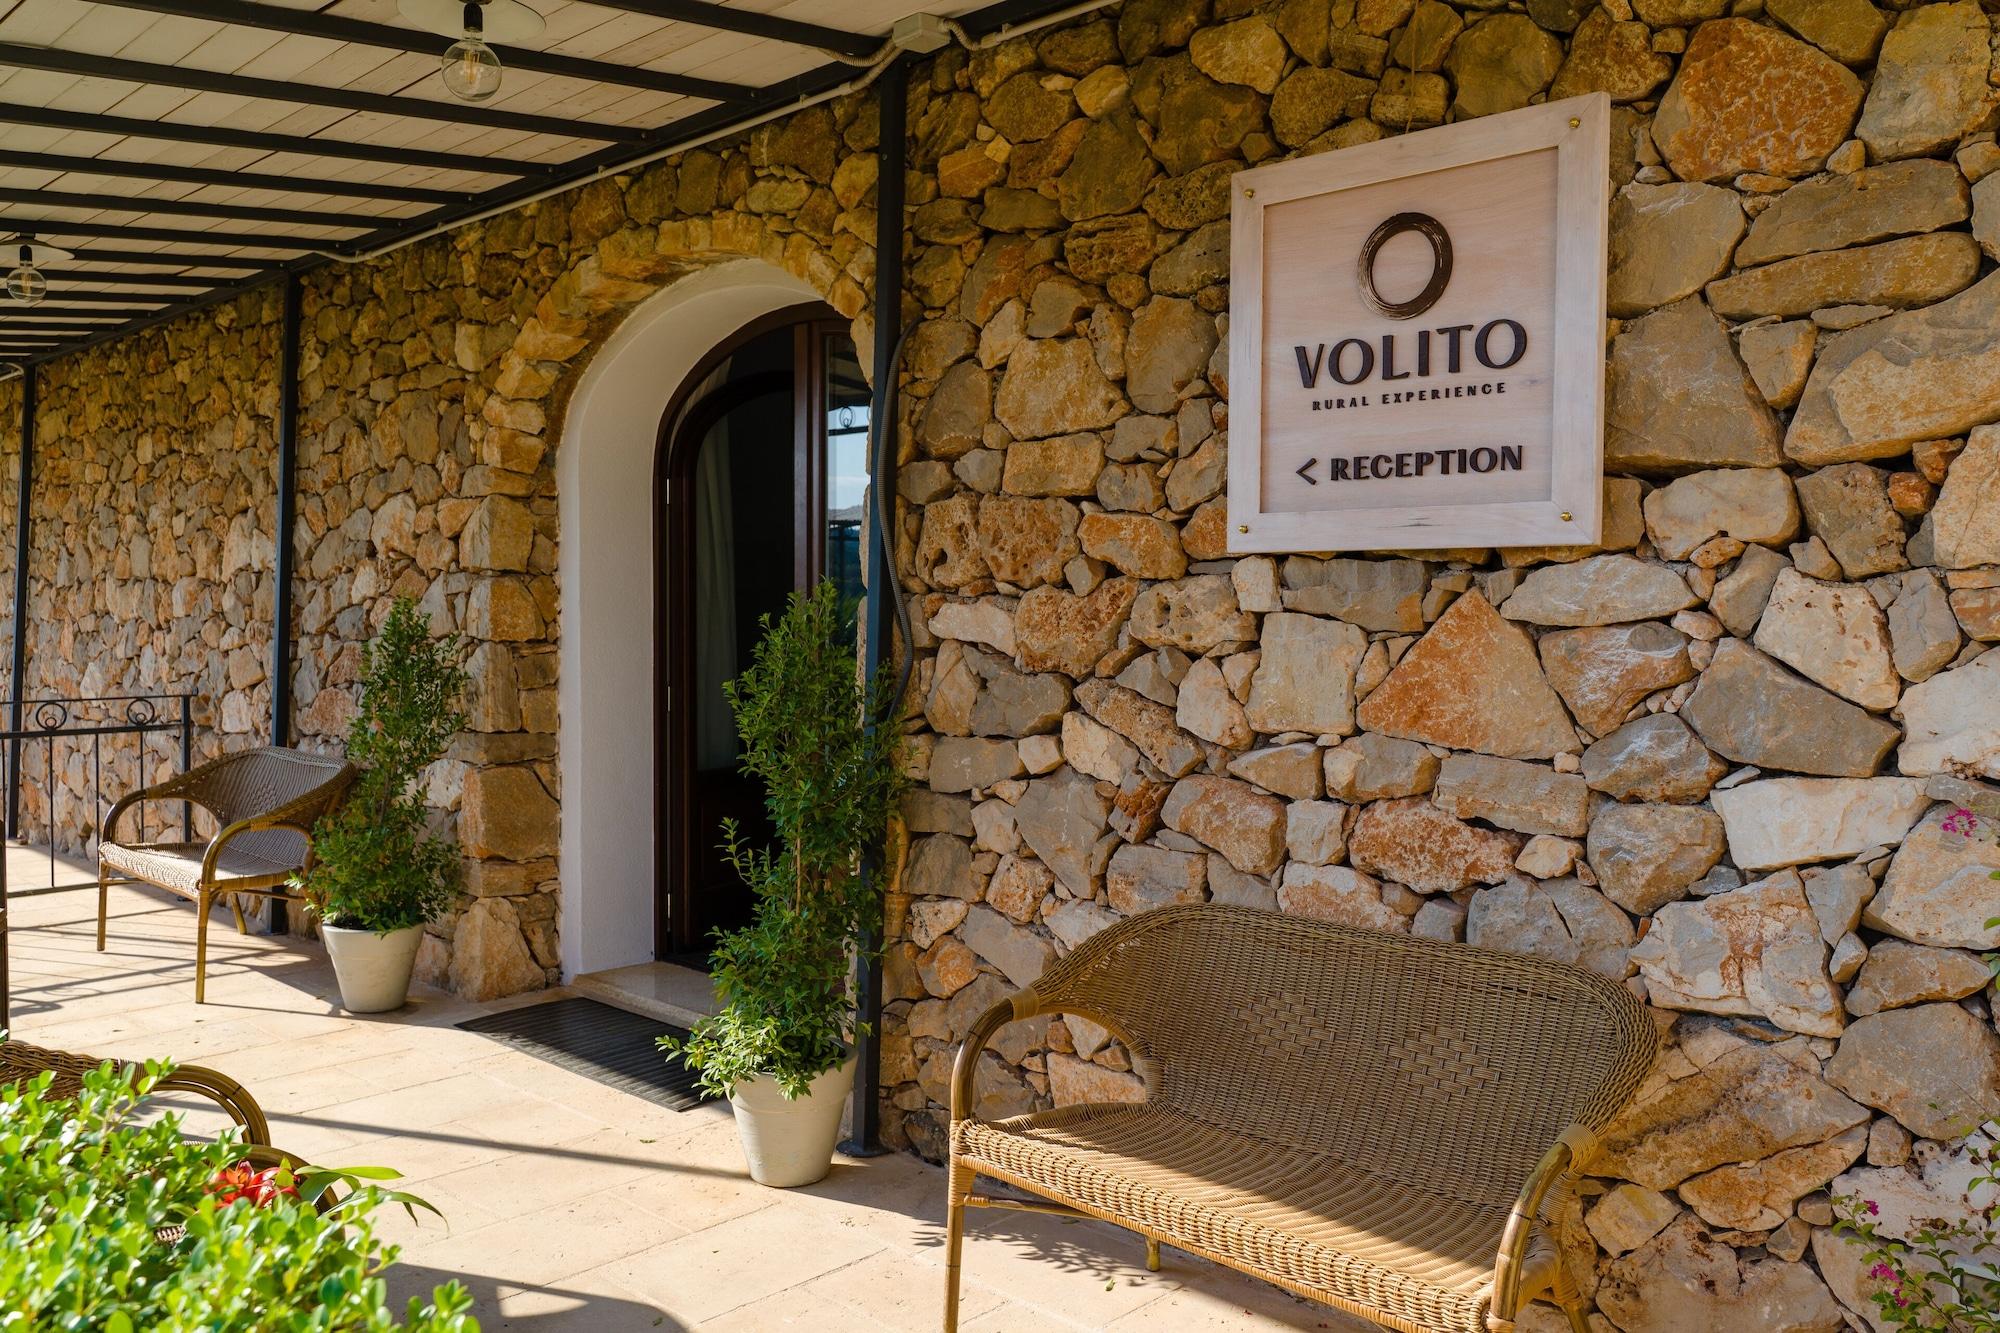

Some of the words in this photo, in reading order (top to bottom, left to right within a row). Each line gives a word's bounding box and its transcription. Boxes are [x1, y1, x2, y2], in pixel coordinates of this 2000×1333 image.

[1294, 319, 1527, 388] VOLITO
[1312, 396, 1369, 410] RURAL
[1381, 382, 1507, 405] EXPERIENCE
[1330, 445, 1523, 481] RECEPTION
